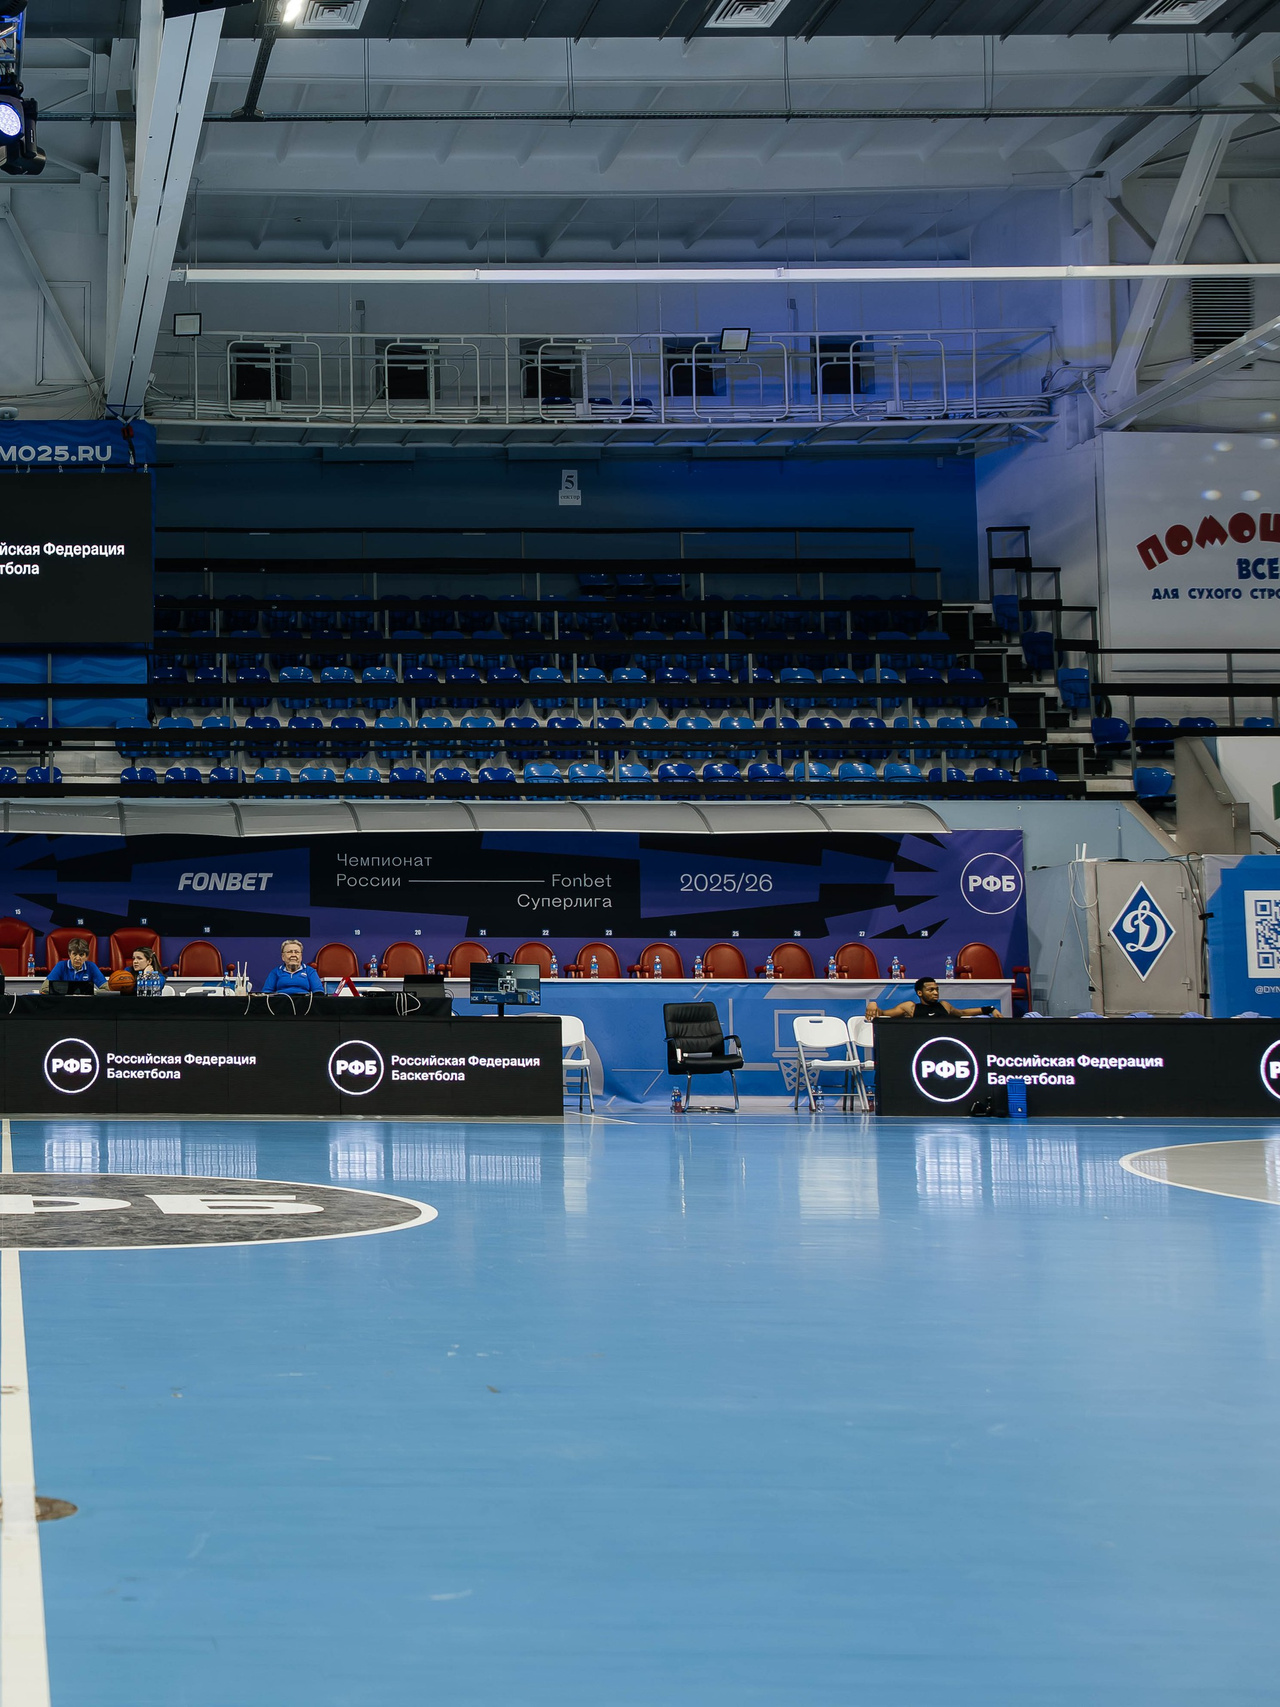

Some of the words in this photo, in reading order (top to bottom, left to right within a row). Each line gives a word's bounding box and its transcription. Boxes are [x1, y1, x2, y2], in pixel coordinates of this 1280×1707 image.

[564, 474, 575, 490] 5
[43, 542, 125, 559] Федерация
[1152, 588, 1180, 600] ДЛЯ
[1187, 587, 1243, 600] СУХОГО
[336, 853, 433, 867] Чемпионат
[177, 872, 274, 891] FONBET
[336, 873, 402, 887] России
[551, 873, 612, 888] Fonbet
[680, 872, 774, 893] 2025/26
[968, 875, 1016, 892] РФБ
[517, 893, 613, 911] Суперлига
[51, 1057, 93, 1074] РФБ
[106, 1052, 182, 1065] Российская
[183, 1053, 257, 1067] Федерация
[335, 1058, 378, 1076] РФБ
[391, 1054, 466, 1067] Российская
[467, 1055, 541, 1069] Федерация
[986, 1054, 1075, 1068] Российская
[1076, 1054, 1164, 1070] Федерация
[106, 1067, 181, 1080] Баскетбола
[391, 1069, 465, 1081] Баскетбола
[921, 1060, 970, 1080] РФБ
